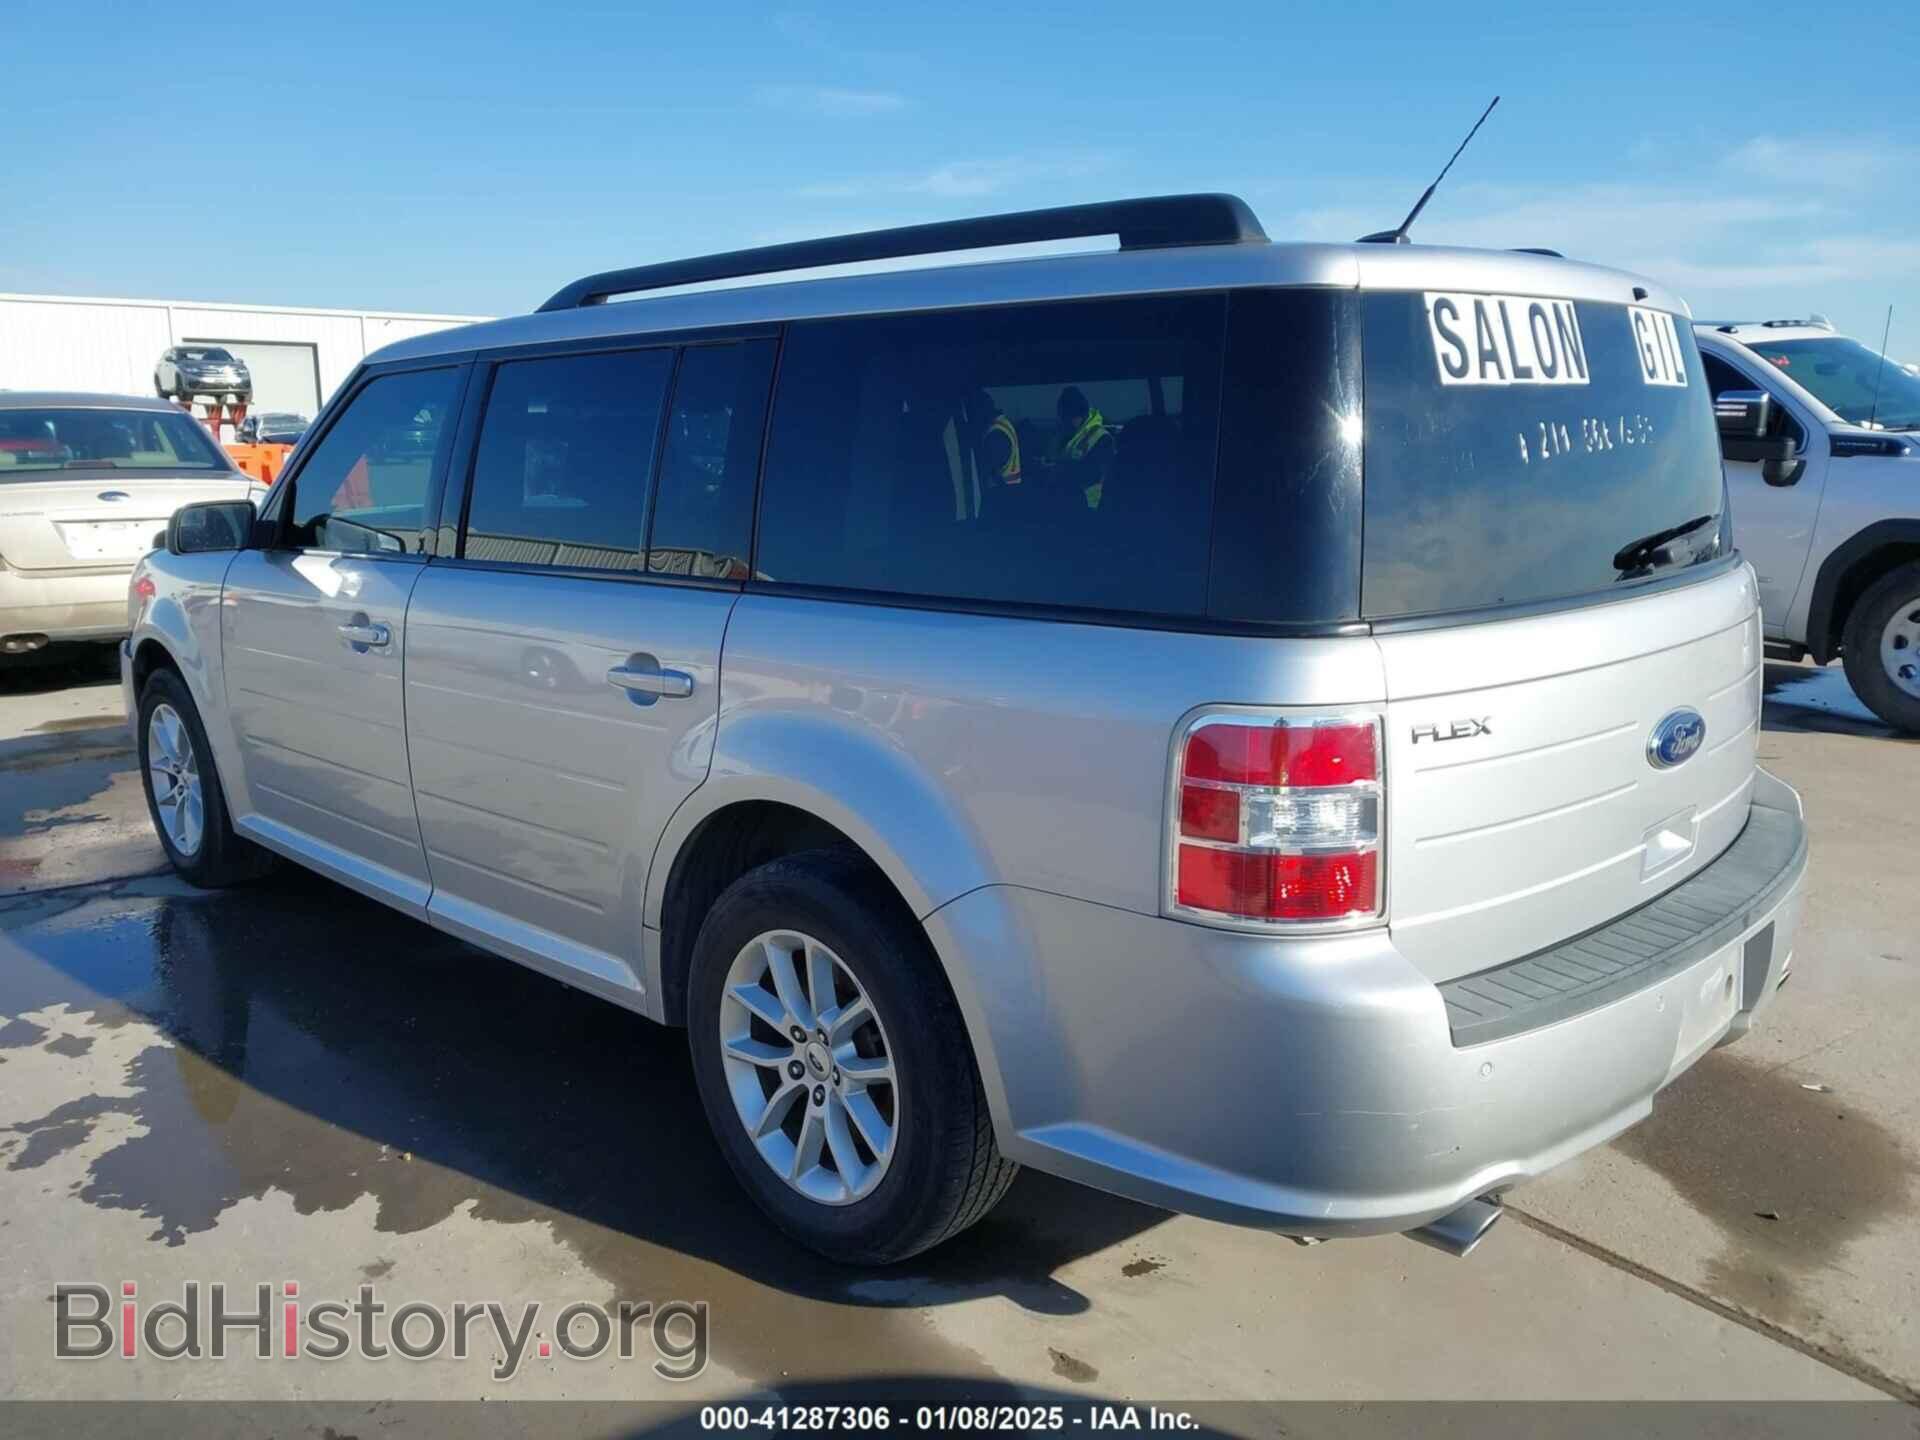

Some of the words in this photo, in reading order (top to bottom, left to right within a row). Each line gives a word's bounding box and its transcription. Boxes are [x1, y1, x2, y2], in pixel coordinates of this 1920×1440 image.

[1433, 297, 1587, 380] SALON
[1634, 310, 1686, 384] GIL
[1411, 715, 1492, 744] FLEX
